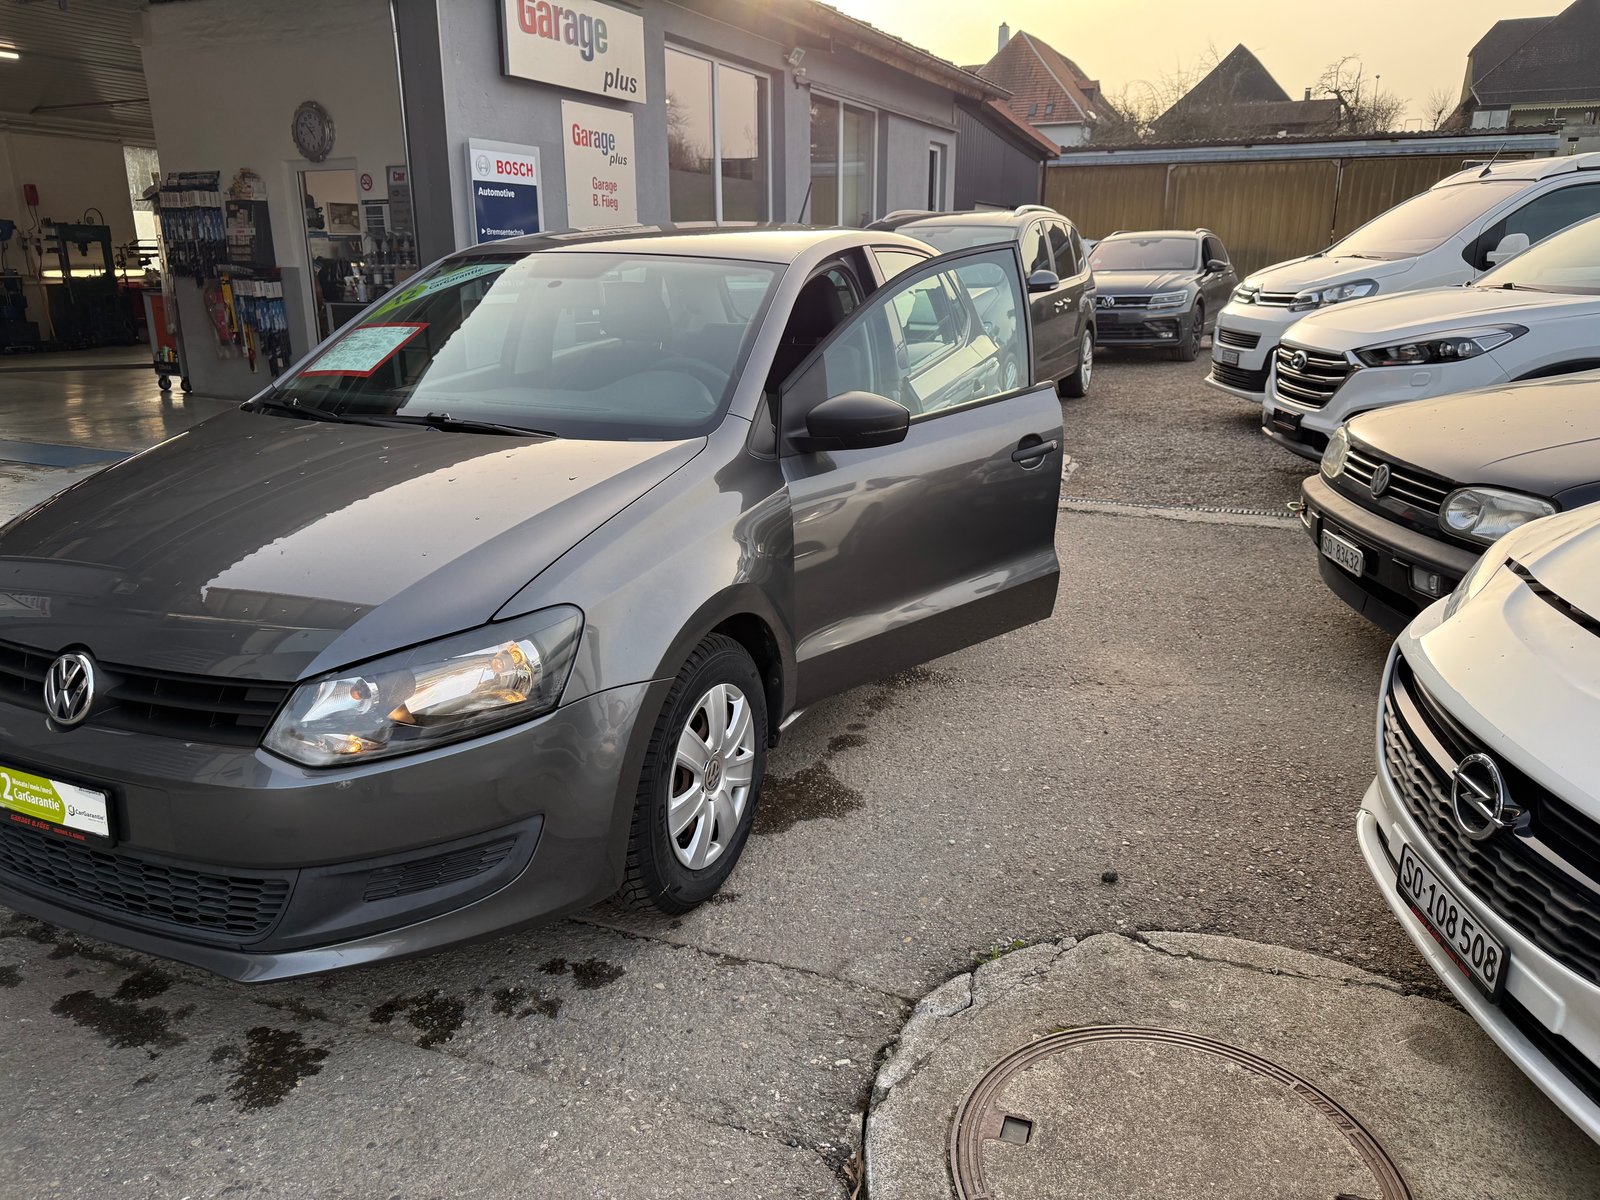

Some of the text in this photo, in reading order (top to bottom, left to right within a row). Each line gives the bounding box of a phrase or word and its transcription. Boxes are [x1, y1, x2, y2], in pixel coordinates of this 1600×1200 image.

[518, 0, 608, 62] Garage
[603, 68, 637, 93] plus
[572, 123, 615, 156] Garage
[609, 152, 628, 166] plus
[496, 160, 534, 177] BOSCH
[478, 187, 515, 198] Automotive
[592, 177, 618, 193] Garage
[593, 194, 619, 211] B. Füeg
[487, 228, 525, 236] Bremsentechnik
[13, 787, 60, 812] CarGarantie
